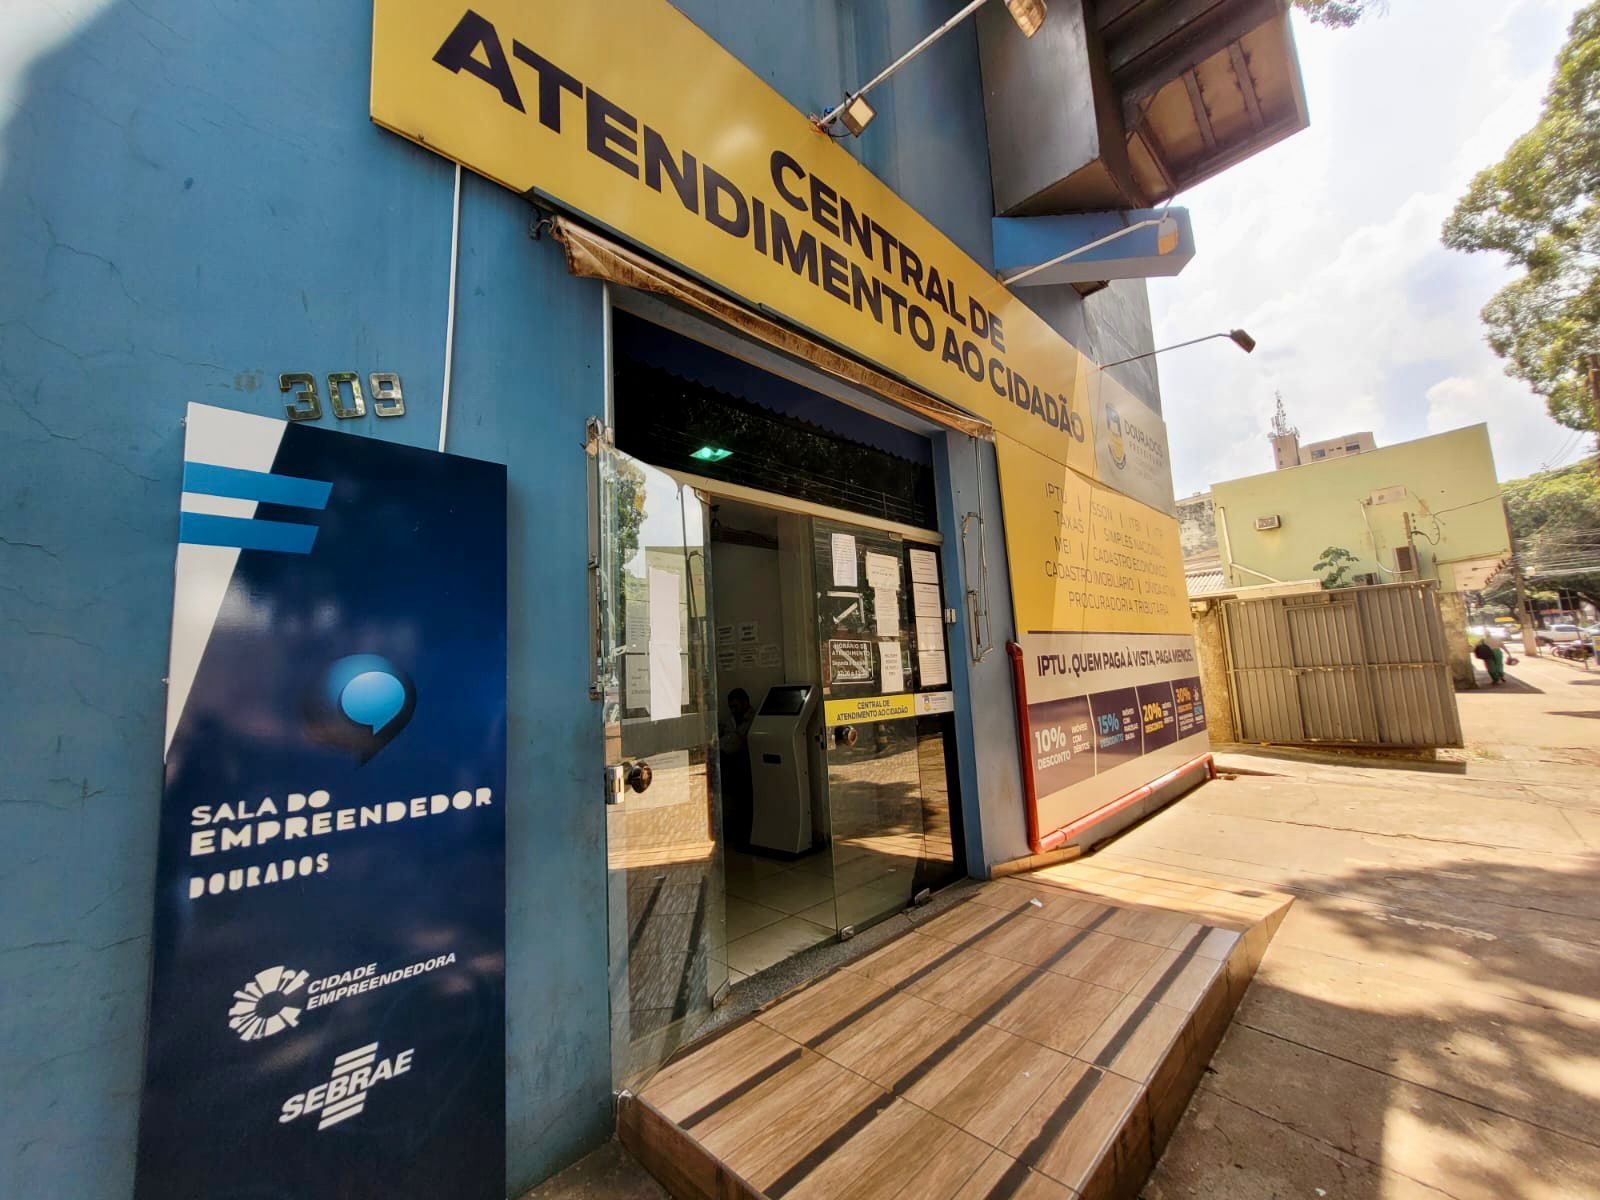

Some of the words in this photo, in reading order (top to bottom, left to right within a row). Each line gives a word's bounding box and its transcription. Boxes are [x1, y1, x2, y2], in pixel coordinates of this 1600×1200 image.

[432, 8, 936, 353] ATENDIMENTO
[942, 326, 985, 383] AO
[989, 357, 1085, 443] CIDADÃO
[770, 149, 966, 328] CENTRAL
[970, 298, 1006, 354] DE
[279, 372, 405, 420] 309
[1054, 510, 1085, 534] TAXAS
[1054, 536, 1071, 555] MEI
[1045, 560, 1093, 584] CADASTRO
[1069, 591, 1134, 612] PROCURADORIA
[1072, 653, 1102, 678] QUEM
[1103, 650, 1127, 670] PAGA
[1126, 646, 1133, 668] À
[1156, 650, 1173, 664] PAGA
[836, 710, 877, 721] ATENDIMENTO
[857, 701, 882, 710] CENTRAL
[1142, 702, 1162, 722] 20%
[1098, 713, 1119, 736] 15%
[1035, 726, 1067, 754] 10%
[1037, 750, 1071, 770] DESCONTO
[190, 787, 492, 856] EMPREENDEDOR
[191, 797, 278, 826] SALA
[287, 790, 330, 813] DO
[189, 853, 329, 899] DOURADOS
[306, 953, 456, 1011] EMPREENDEDORA
[307, 963, 377, 995] CIDADE
[279, 1048, 415, 1124] SEBRAE
